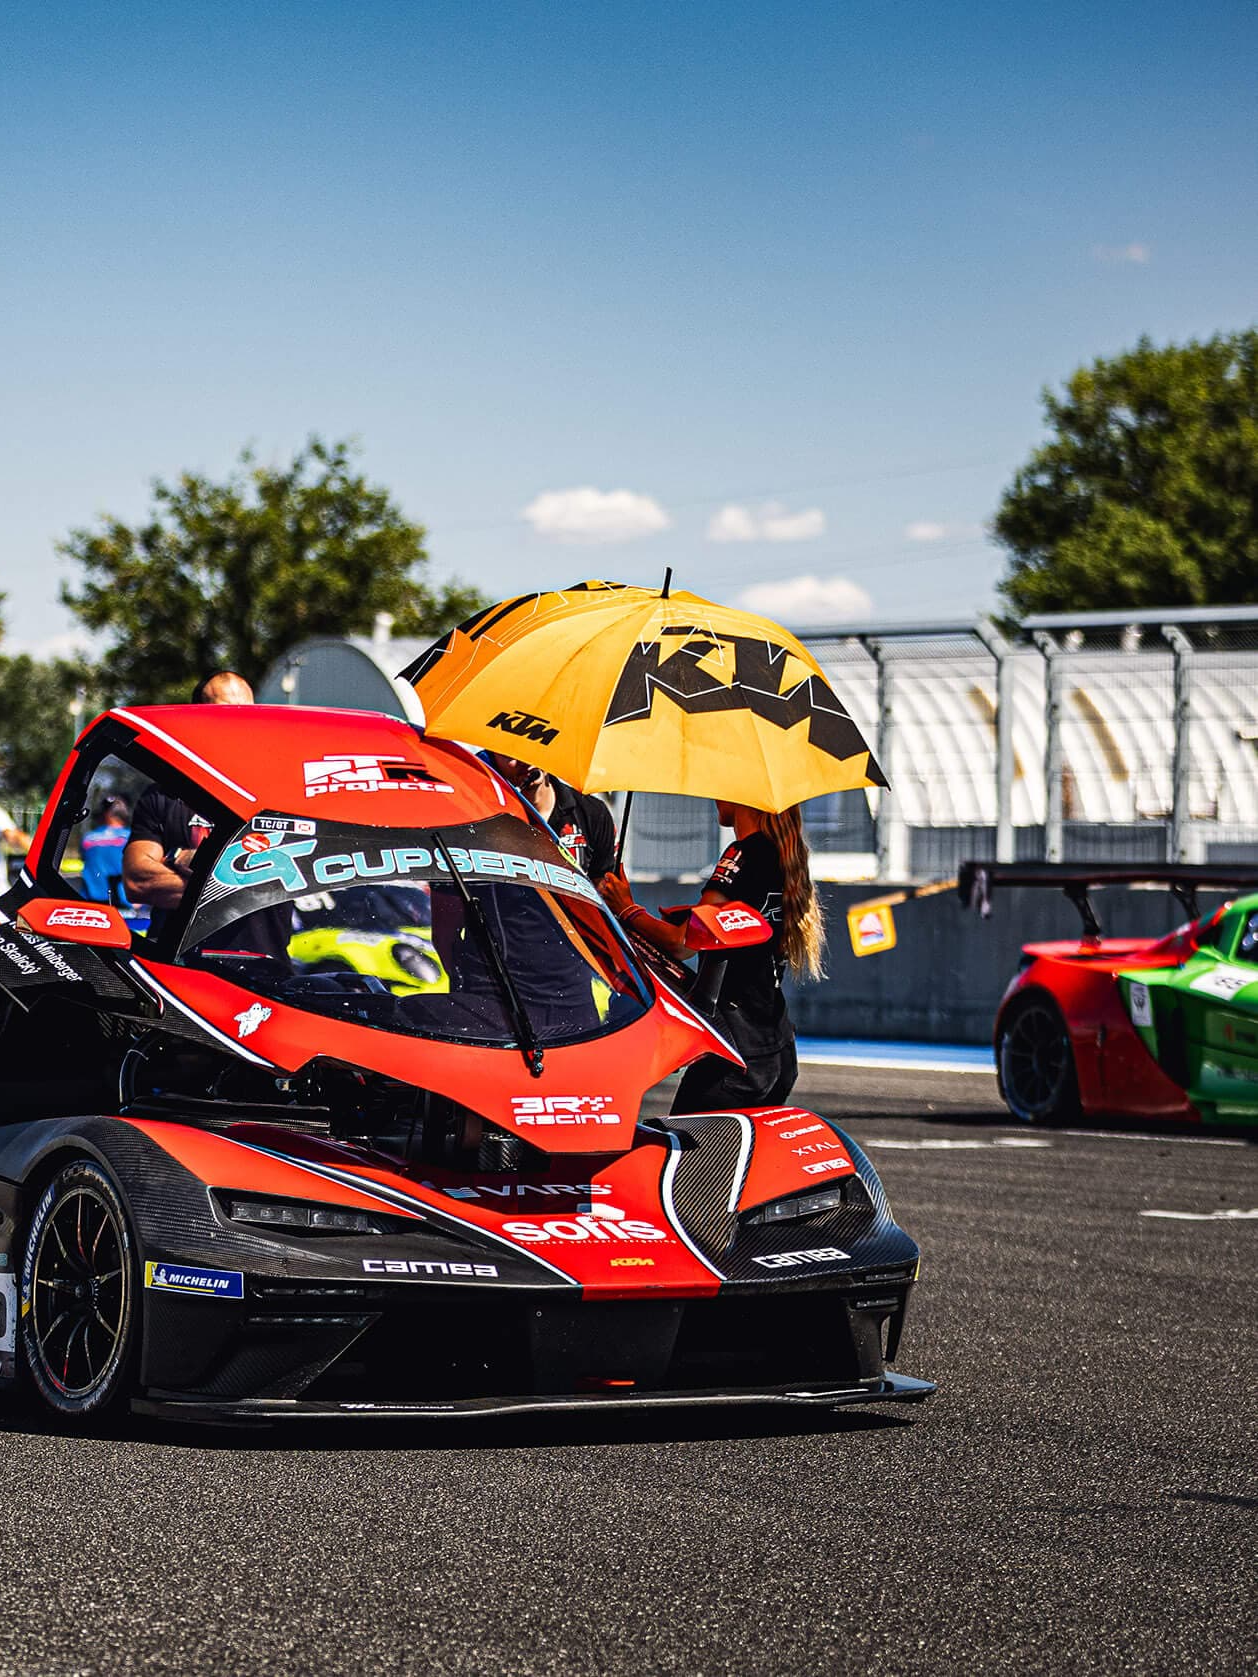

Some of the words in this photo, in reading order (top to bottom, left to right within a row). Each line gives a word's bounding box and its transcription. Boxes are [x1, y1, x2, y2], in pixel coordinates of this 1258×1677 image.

[486, 710, 561, 747] KTM
[305, 780, 455, 799] projects
[33, 941, 84, 982] Miniberger
[791, 1141, 841, 1157] XTAL
[476, 1184, 612, 1197] VARS
[23, 1190, 54, 1280] MICHELIN
[750, 1246, 853, 1269] camea
[361, 1259, 500, 1278] camea
[168, 1272, 231, 1290] MICHELIN
